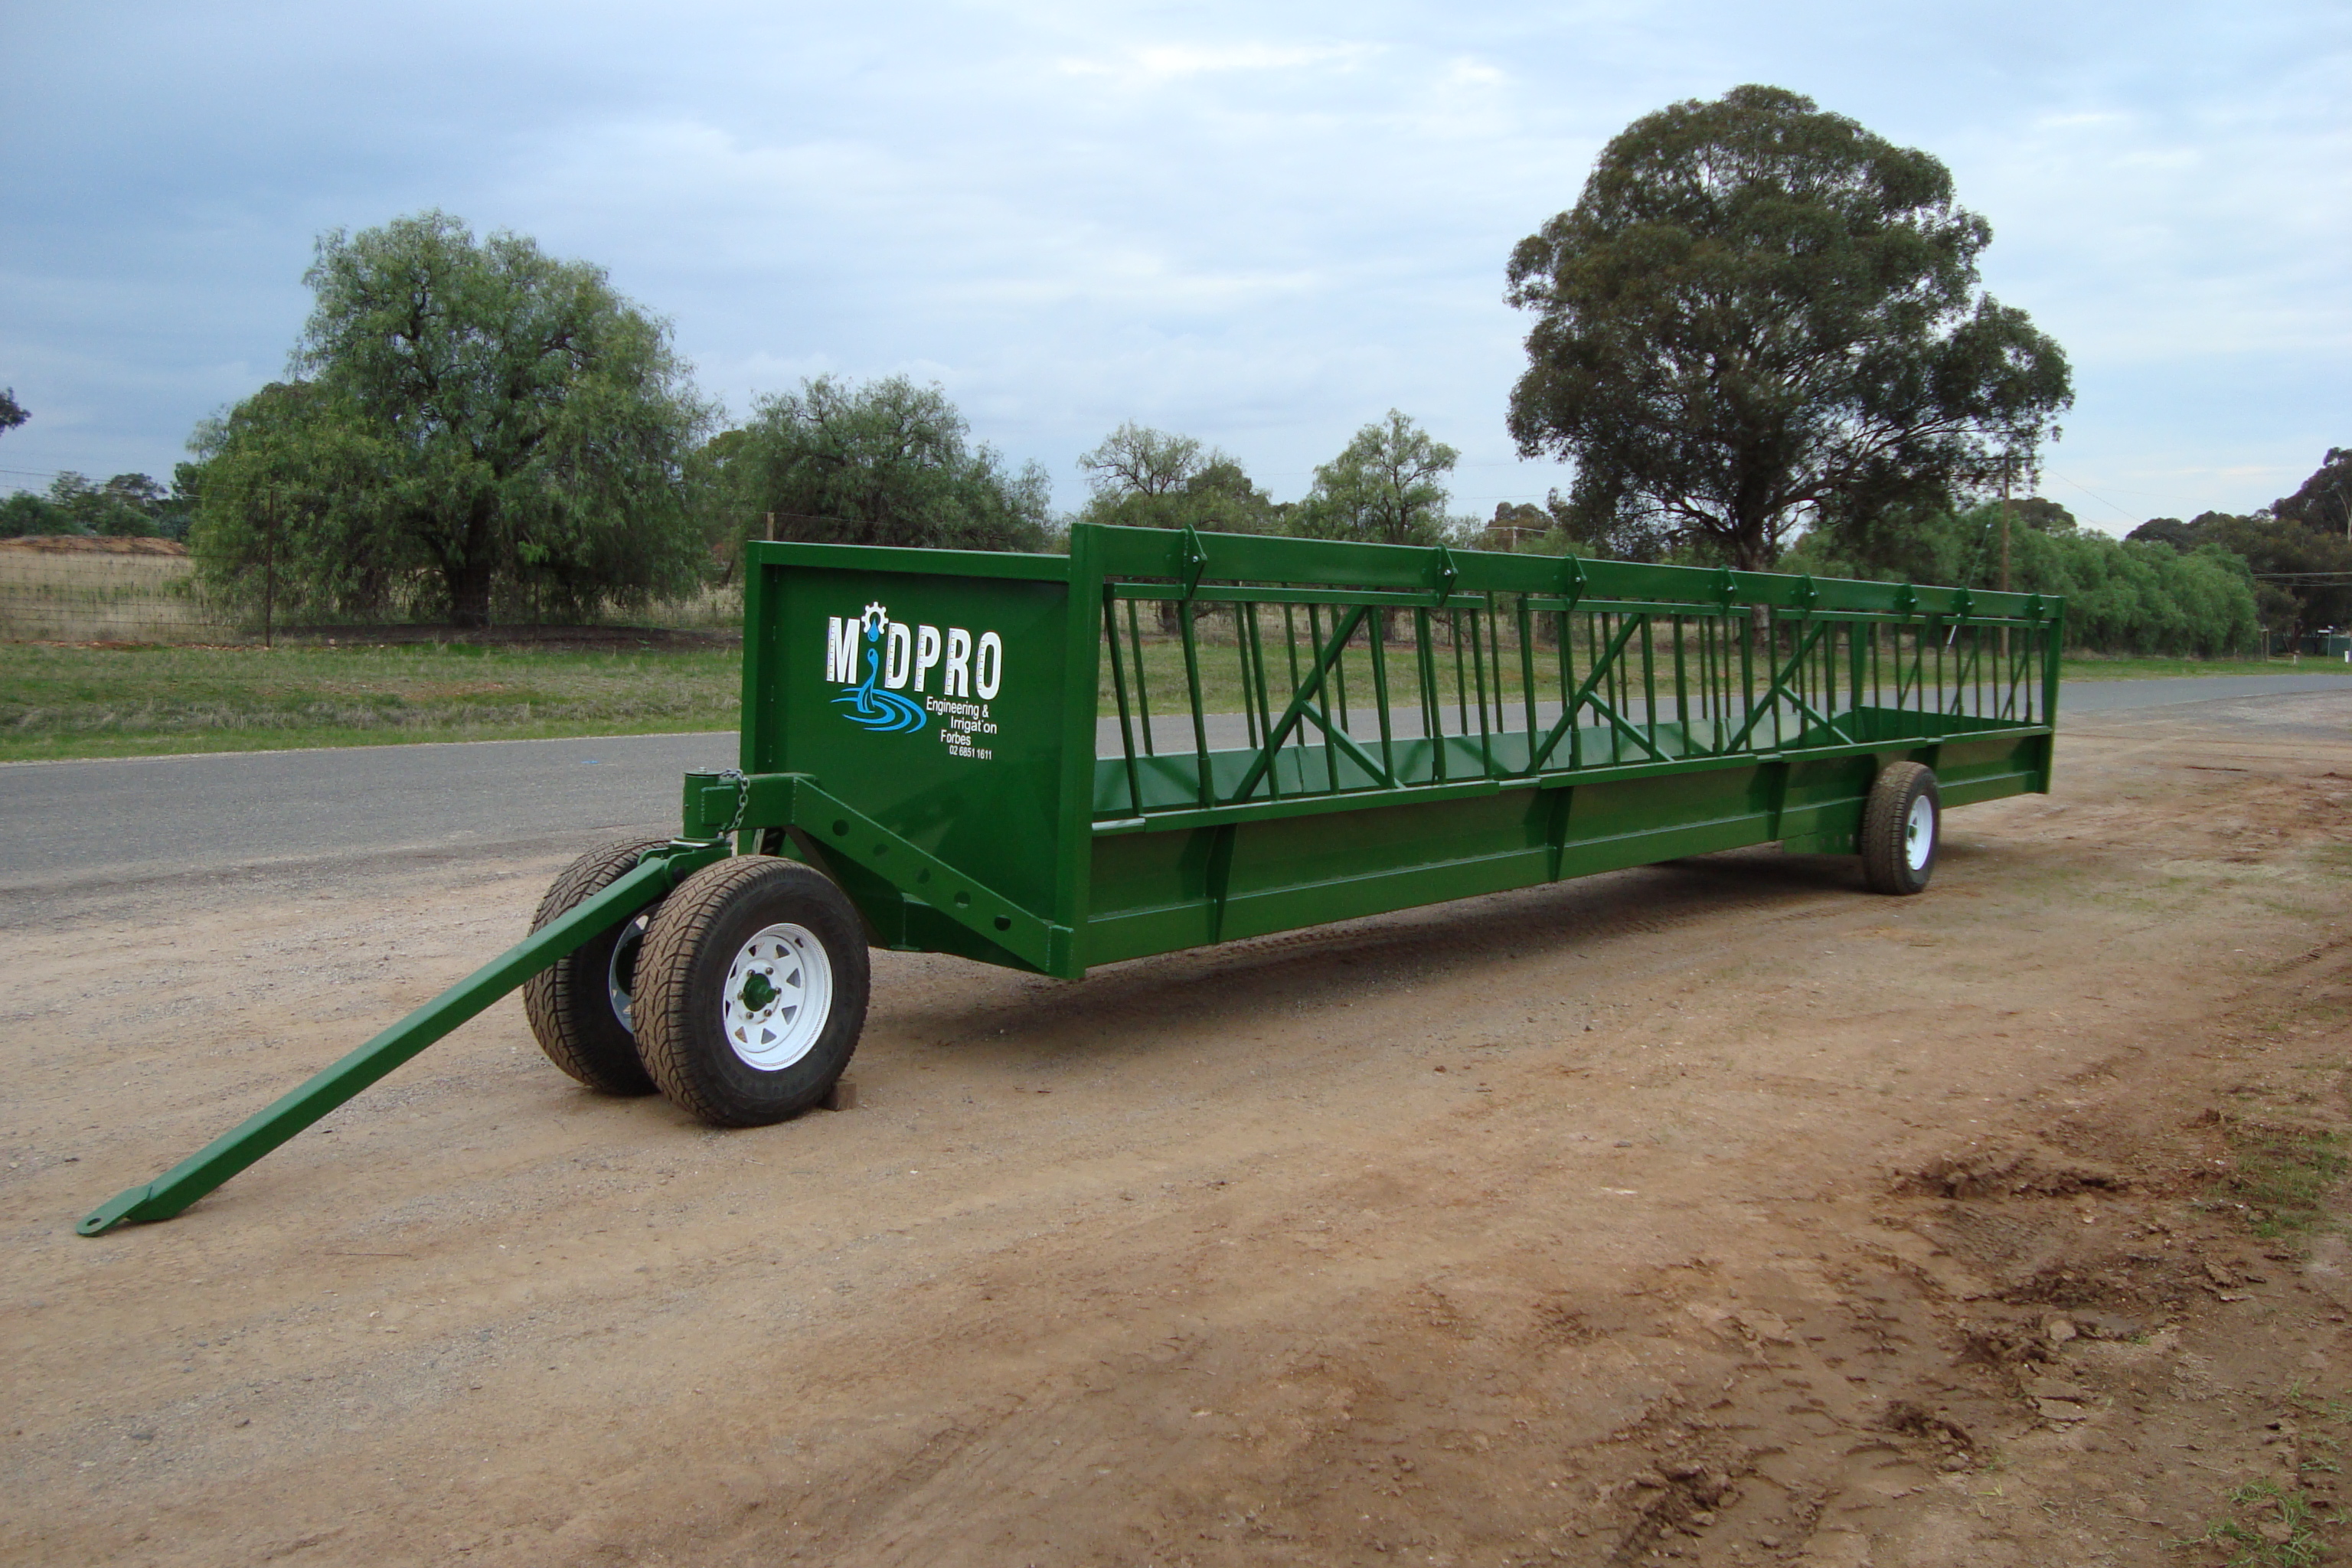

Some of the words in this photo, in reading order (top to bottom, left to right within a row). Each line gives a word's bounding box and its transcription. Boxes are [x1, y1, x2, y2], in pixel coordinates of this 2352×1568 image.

[926, 695, 980, 720] Engineering
[982, 704, 989, 718] &
[950, 715, 998, 734] Irrigaton
[940, 729, 972, 746] Forbes
[949, 745, 959, 756] 02
[959, 746, 975, 758] 6851
[976, 748, 992, 760] 1611
